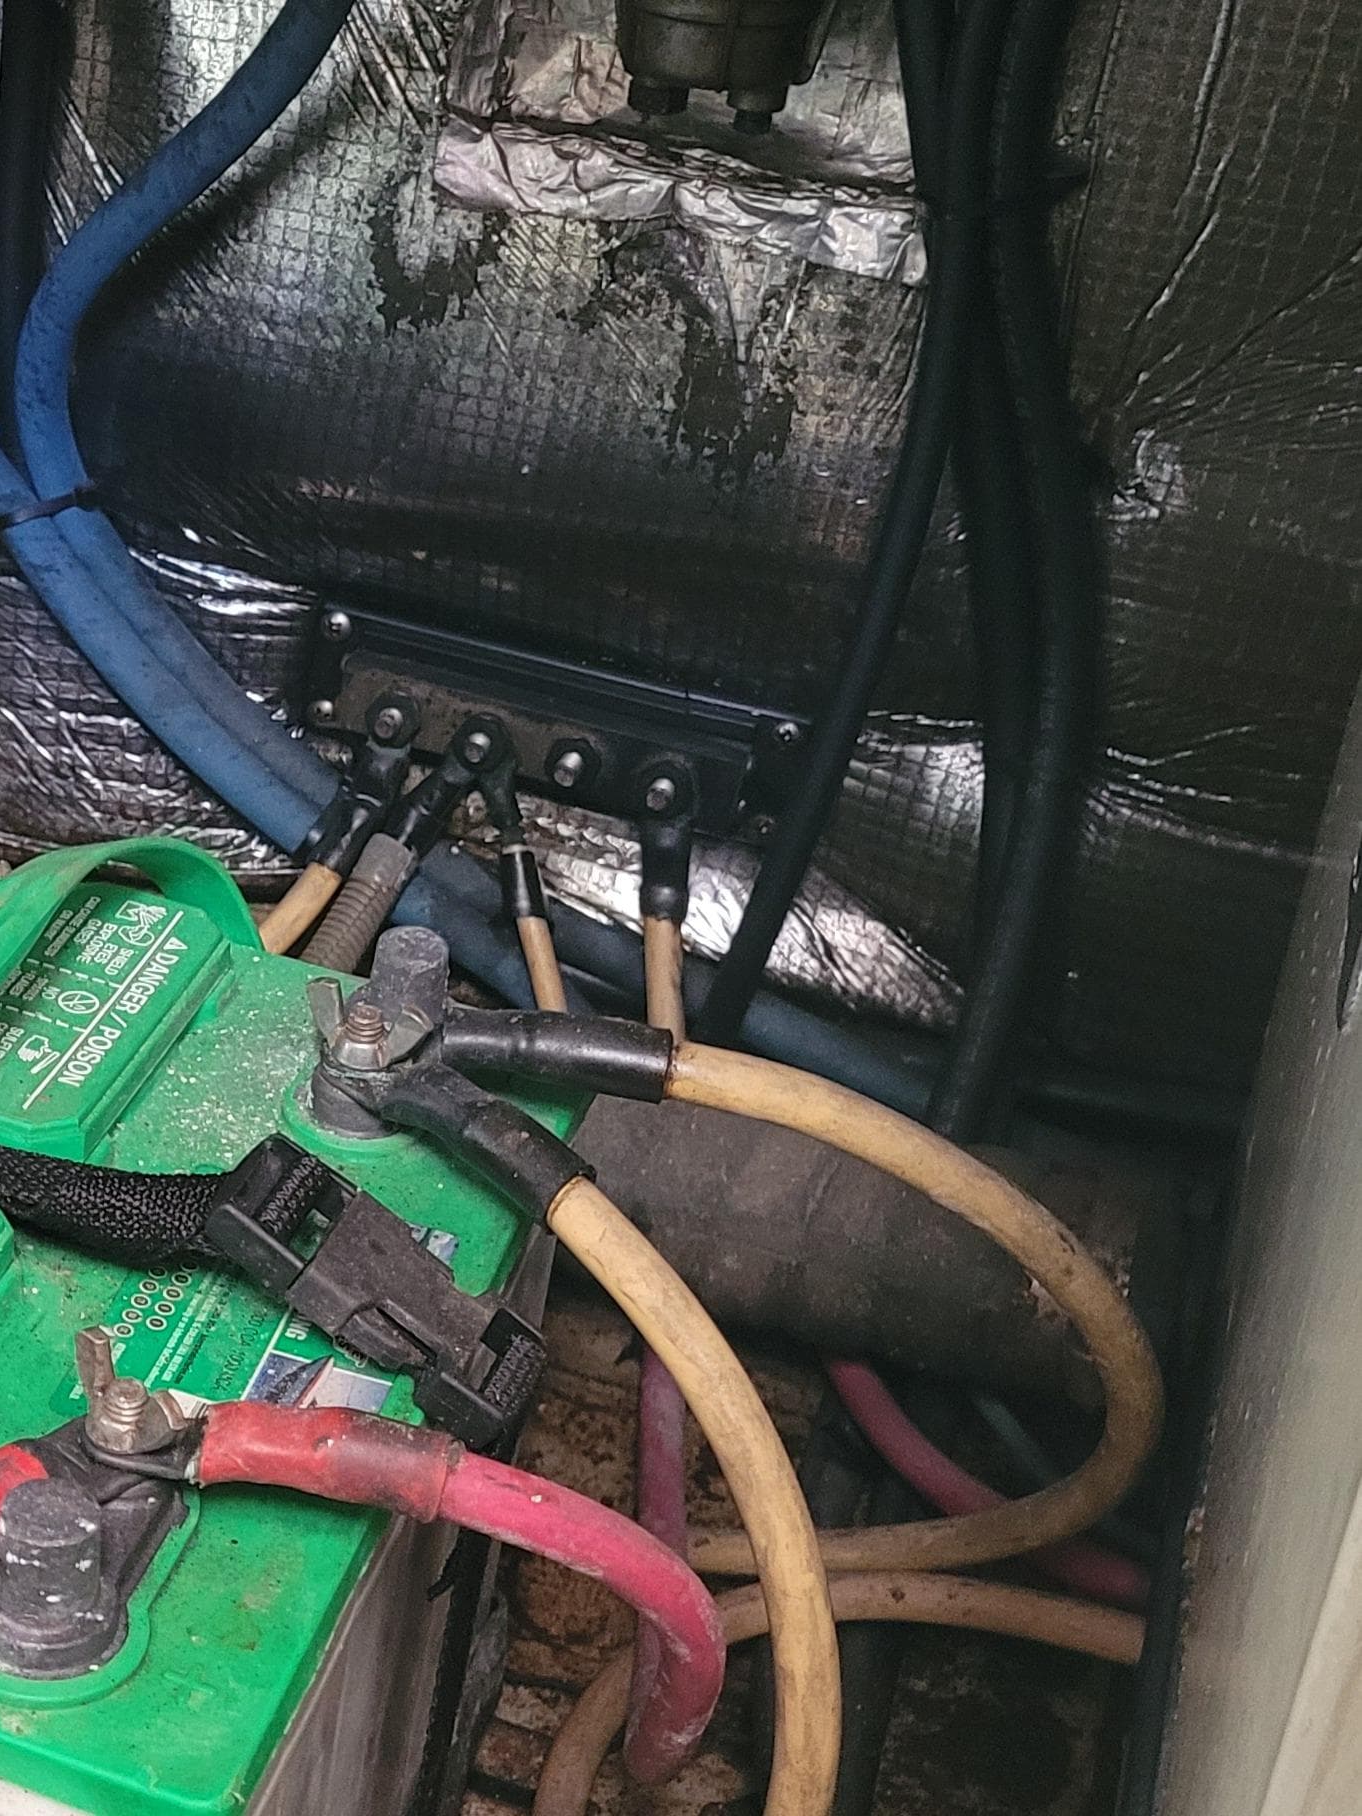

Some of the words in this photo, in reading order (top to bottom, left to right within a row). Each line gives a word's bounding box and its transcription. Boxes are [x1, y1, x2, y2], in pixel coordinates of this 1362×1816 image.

[70, 917, 104, 945] GASES
[74, 921, 119, 964] EXPLOSIVE
[91, 941, 120, 965] EYES
[101, 946, 136, 977] SHIELD
[38, 984, 62, 1001] NO
[111, 950, 182, 1015] DANGER
[102, 1010, 134, 1027] /
[54, 1023, 124, 1087] POISON
